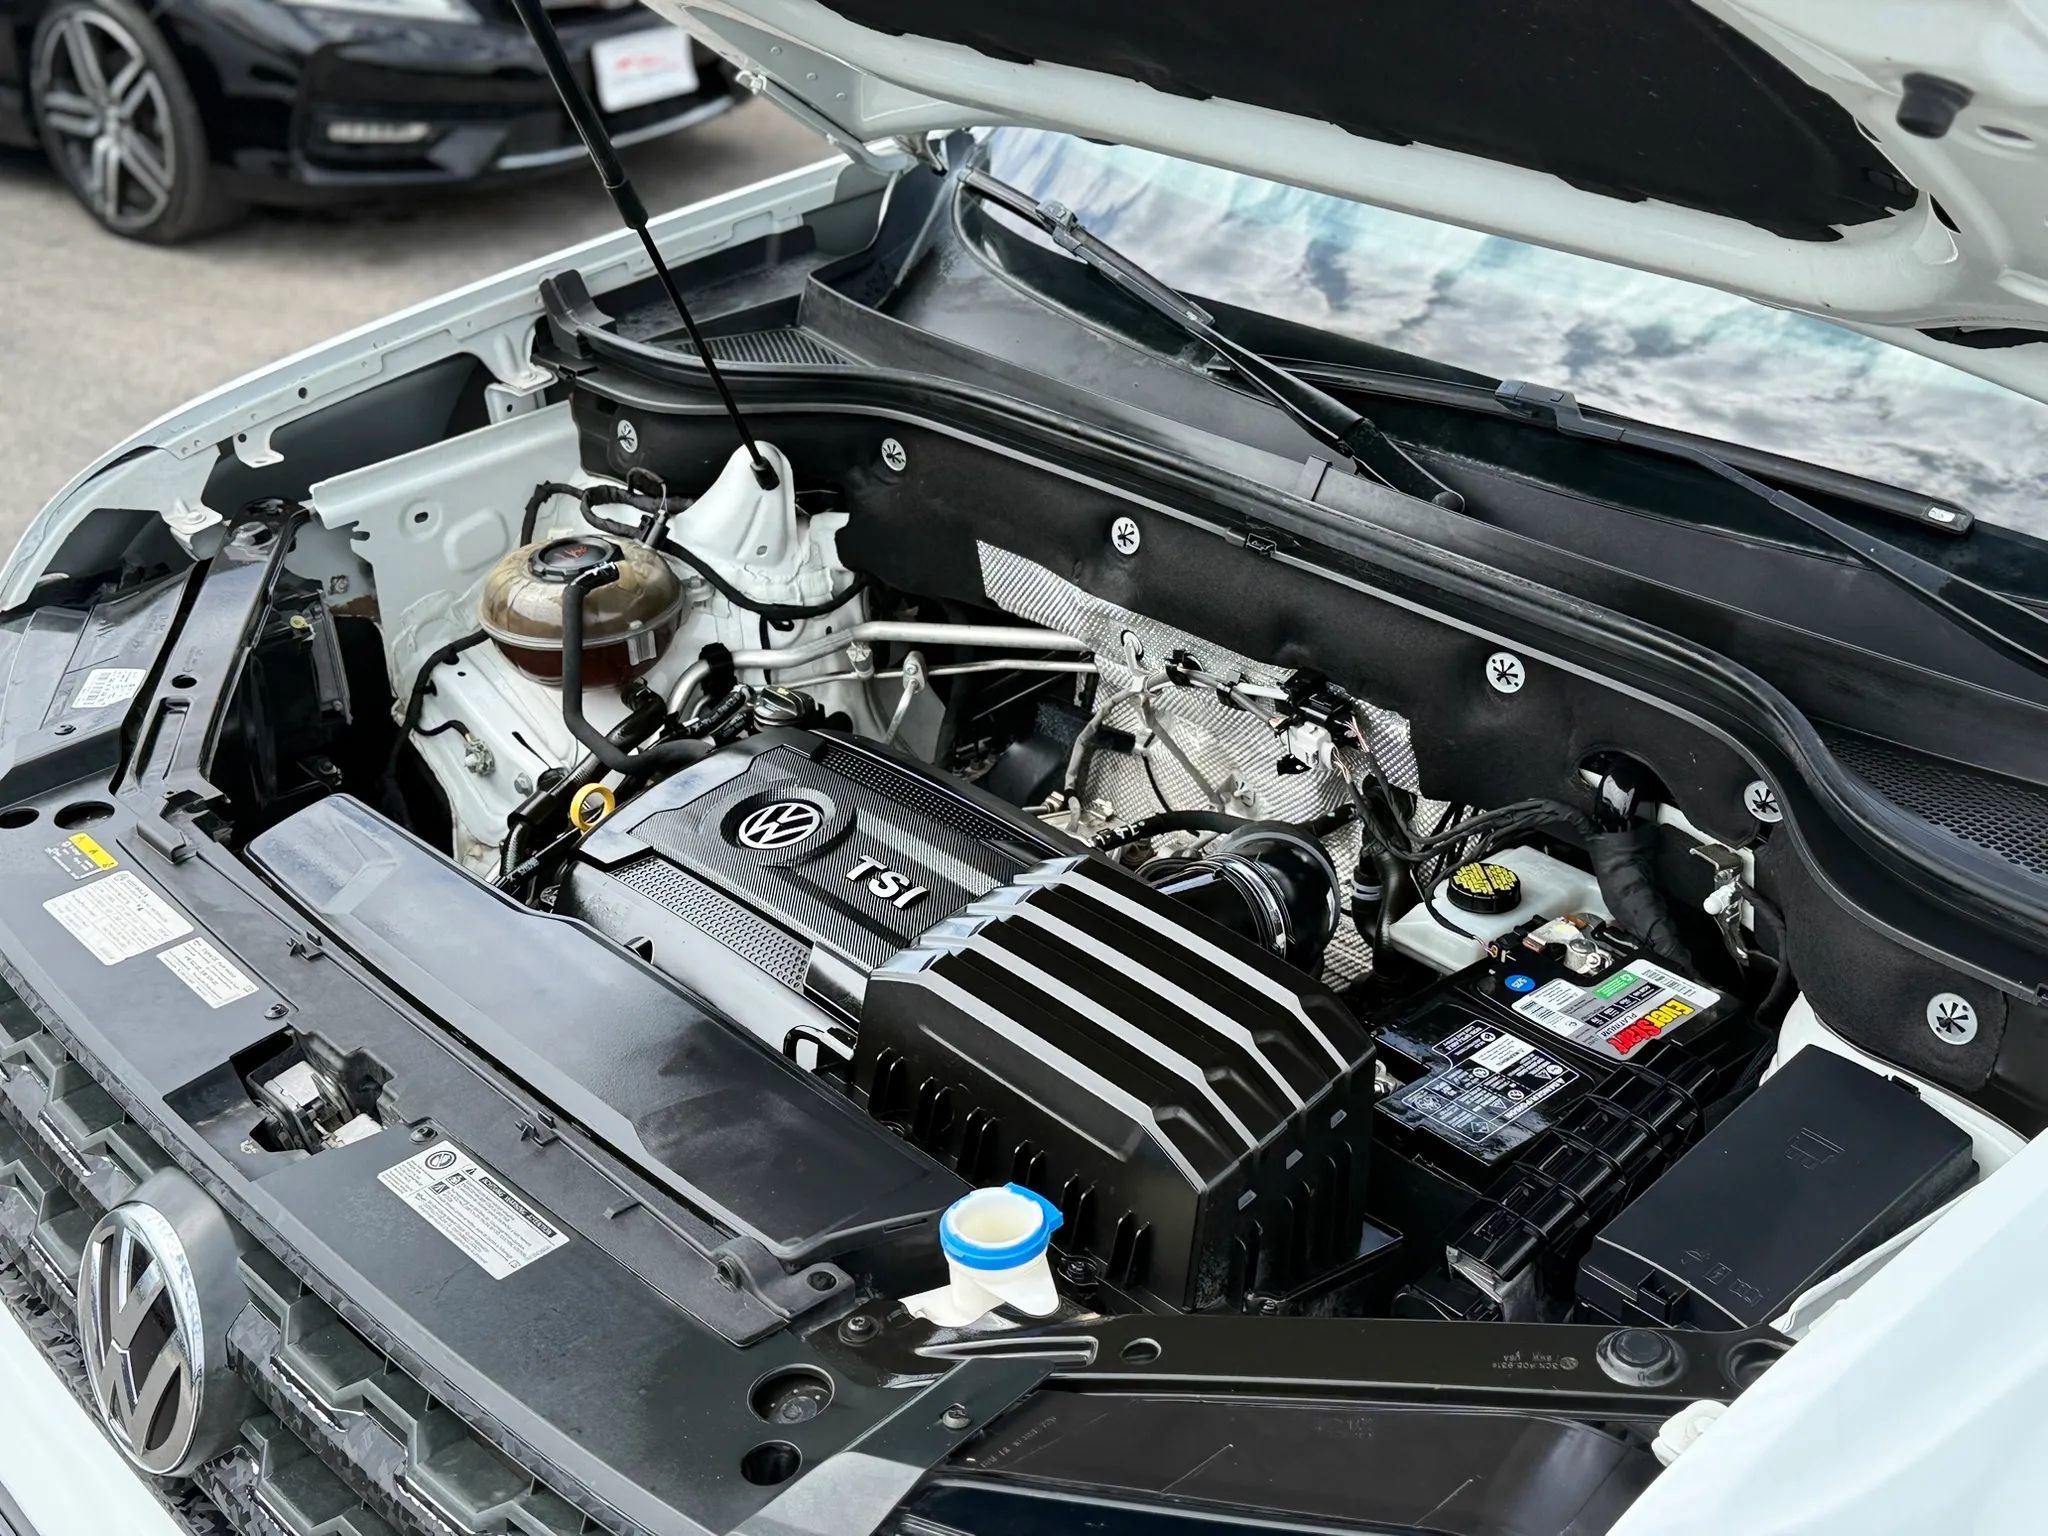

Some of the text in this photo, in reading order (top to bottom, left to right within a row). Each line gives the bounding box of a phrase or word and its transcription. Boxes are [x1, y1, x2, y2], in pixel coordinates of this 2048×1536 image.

[846, 855, 928, 909] TSI
[1598, 1012, 1639, 1037] PLATINUM
[1605, 996, 1697, 1055] EverStart
